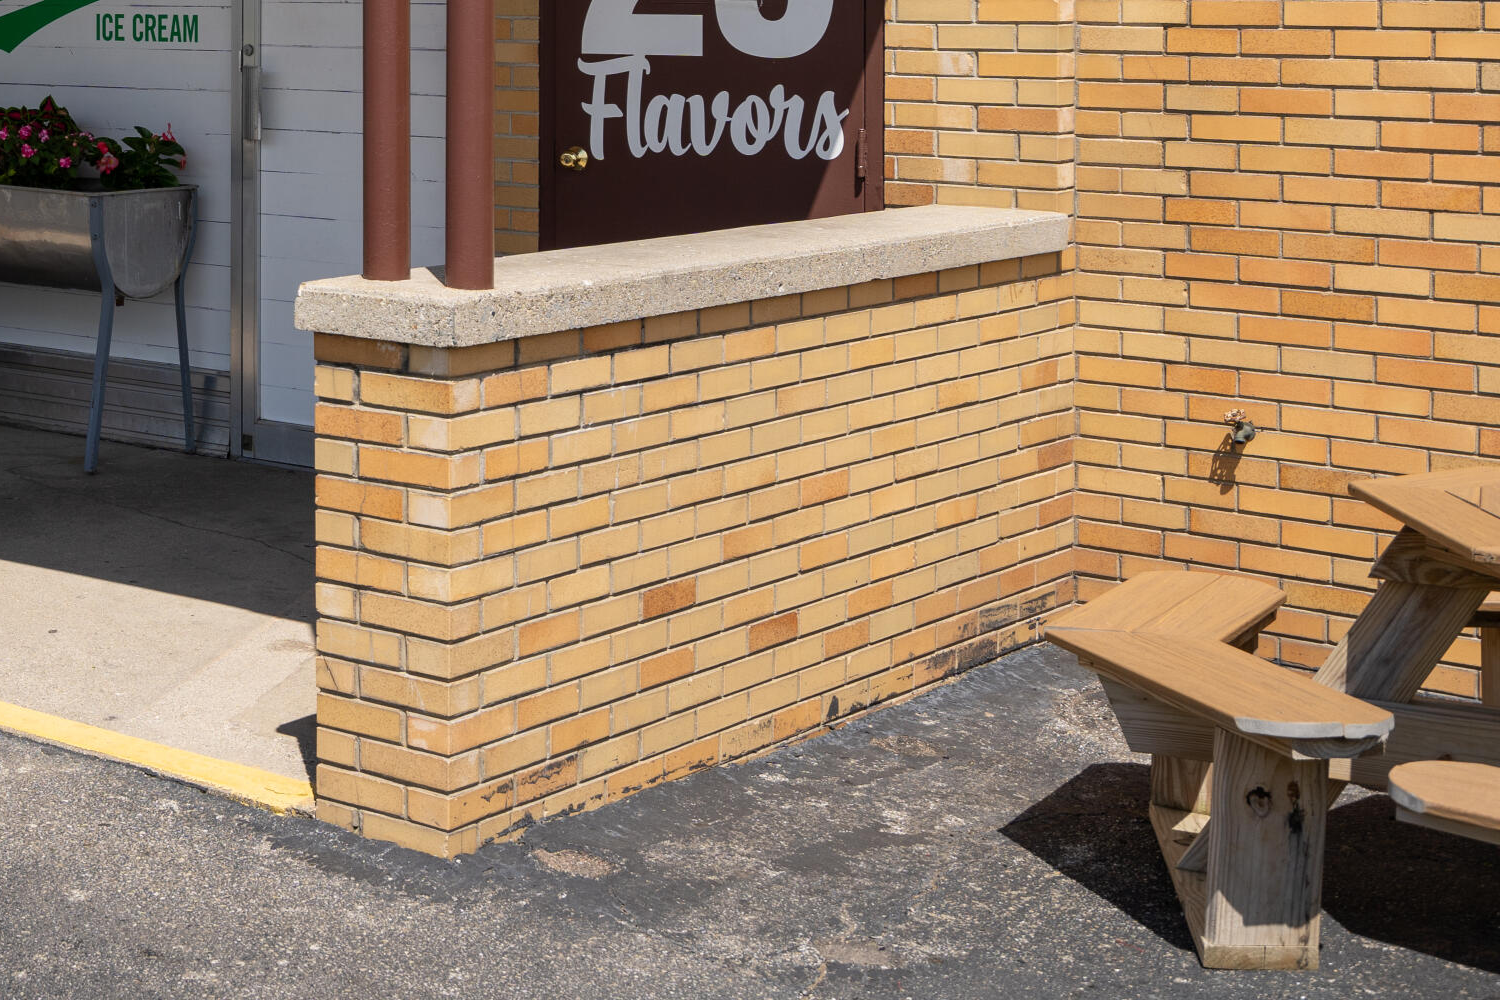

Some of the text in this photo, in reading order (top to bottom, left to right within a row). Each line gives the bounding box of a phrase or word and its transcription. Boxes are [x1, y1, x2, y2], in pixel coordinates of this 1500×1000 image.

[96, 13, 199, 43] ICE CREAM
[577, 53, 850, 161] Flavors
